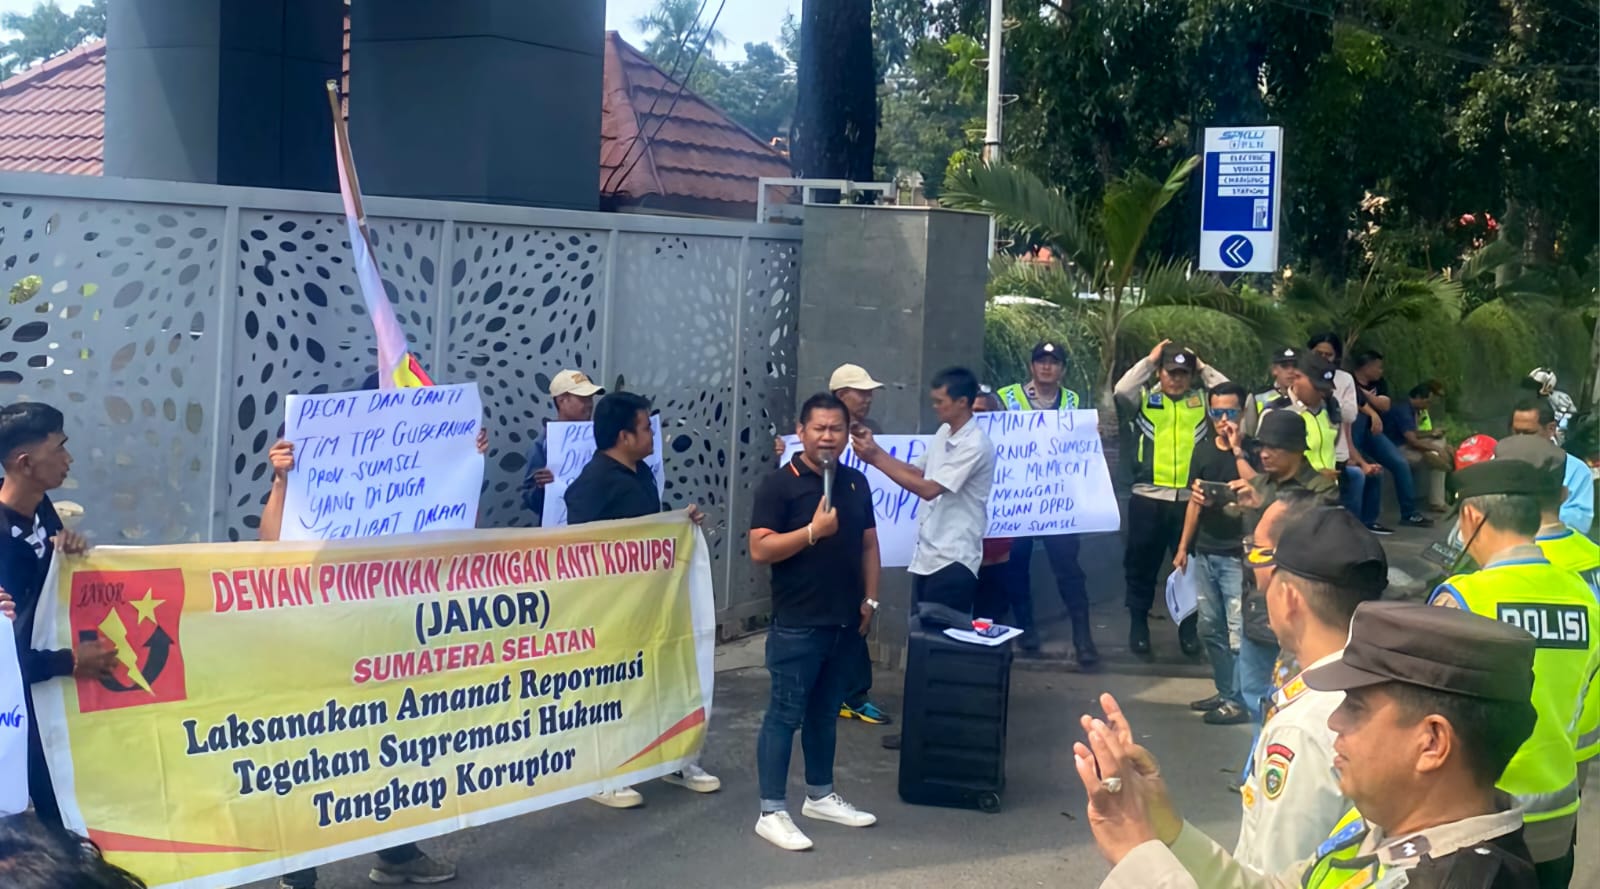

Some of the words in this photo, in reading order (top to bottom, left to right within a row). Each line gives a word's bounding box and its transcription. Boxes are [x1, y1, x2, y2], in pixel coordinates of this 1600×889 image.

[297, 396, 358, 429] PECAT
[368, 391, 405, 413] DAN
[412, 388, 464, 407] GANTI
[976, 411, 1047, 436] MINTA
[351, 428, 385, 457] TPP
[392, 419, 477, 447] GUBERNUR
[995, 441, 1038, 461] RNUR
[1047, 437, 1101, 456] SUMSEL
[351, 450, 423, 481] SUMSEL
[299, 494, 355, 530] YANG
[385, 476, 426, 505] DUGA
[413, 502, 468, 533] DALAM
[1039, 496, 1075, 515] DPRD
[211, 565, 314, 613] DEWAN
[319, 556, 441, 604] PIMPINAN
[446, 548, 550, 591] JARINGAN
[555, 543, 600, 579] ANTI
[600, 537, 677, 575] KORUPSI
[415, 590, 551, 645] (JAKOR)
[353, 643, 496, 684] SUMATERA
[502, 626, 597, 662] SELATAN
[182, 698, 388, 755] Laksanakan
[396, 674, 512, 721] Amanat
[519, 650, 645, 700] Repormasi
[233, 746, 371, 796] Tegakan
[378, 709, 532, 768] Supremasi
[538, 699, 623, 736] Hukum
[313, 775, 447, 827] Tangkap
[455, 746, 576, 796] Koruptor
